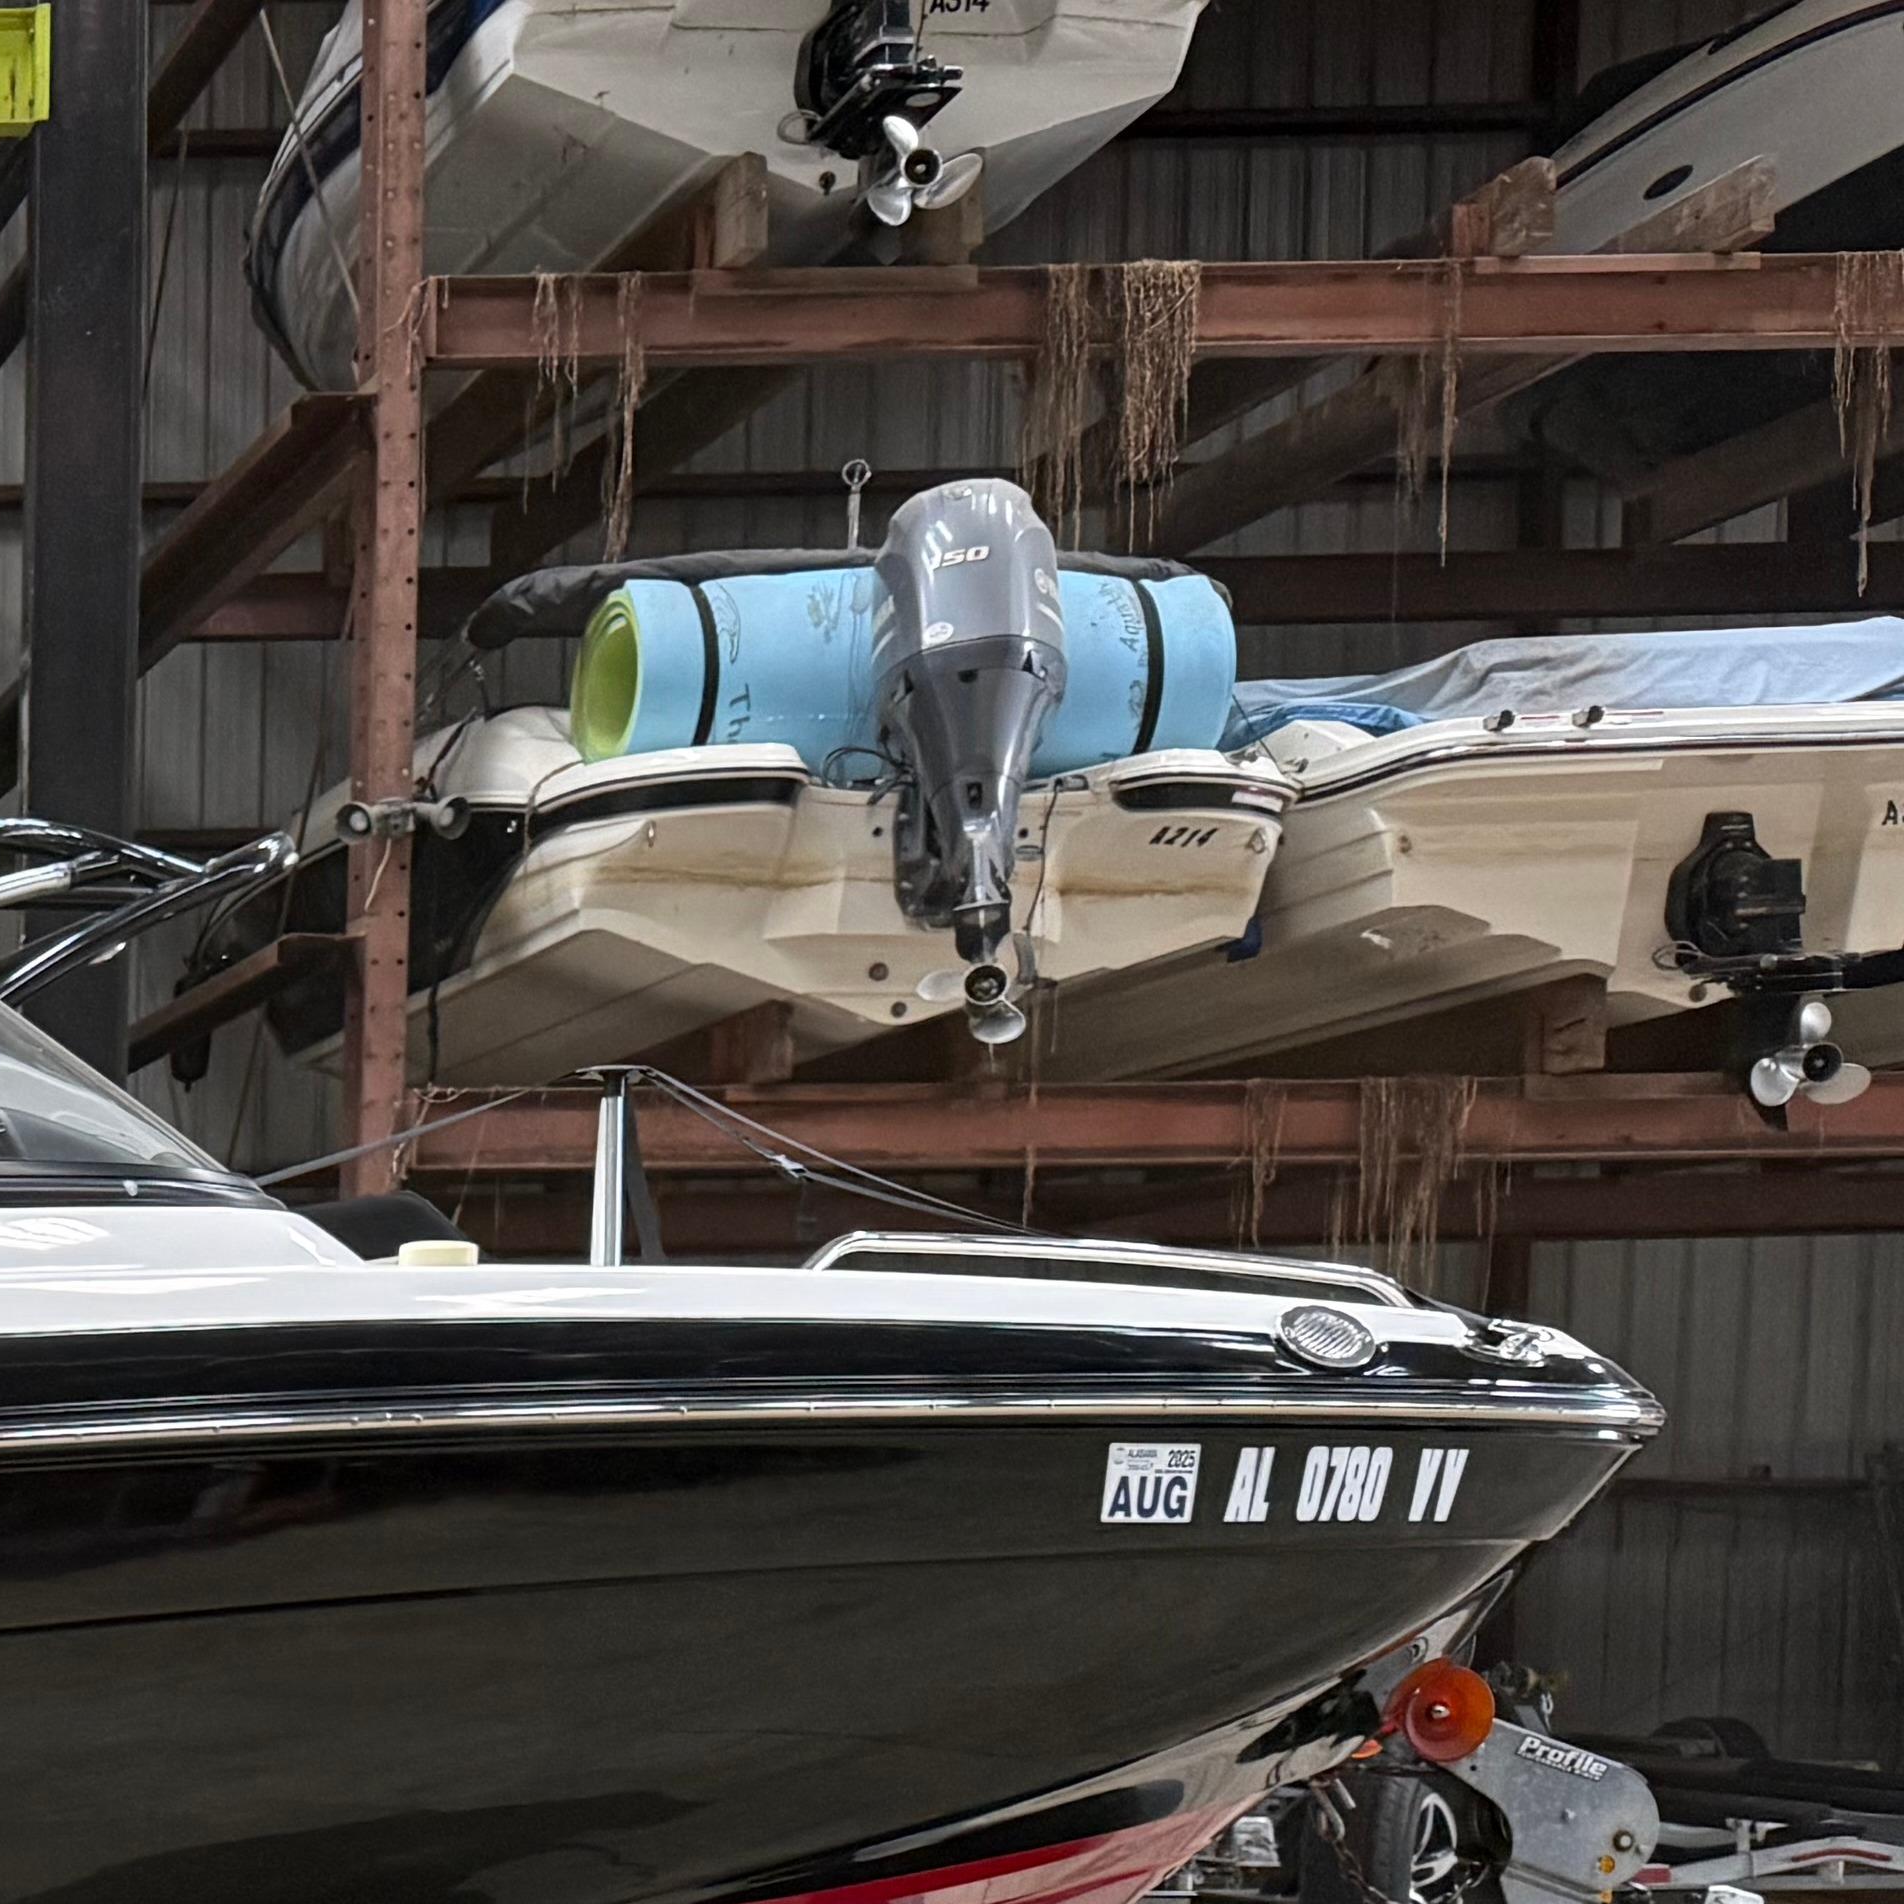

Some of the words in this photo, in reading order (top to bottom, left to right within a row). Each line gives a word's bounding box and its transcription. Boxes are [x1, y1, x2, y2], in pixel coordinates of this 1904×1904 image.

[727, 682, 751, 743] Th
[1880, 799, 1904, 827] A
[1107, 1475, 1188, 1519] AUG
[1222, 1446, 1276, 1523] AL
[1295, 1445, 1394, 1523] 0780
[1518, 1735, 1609, 1777] Profile
